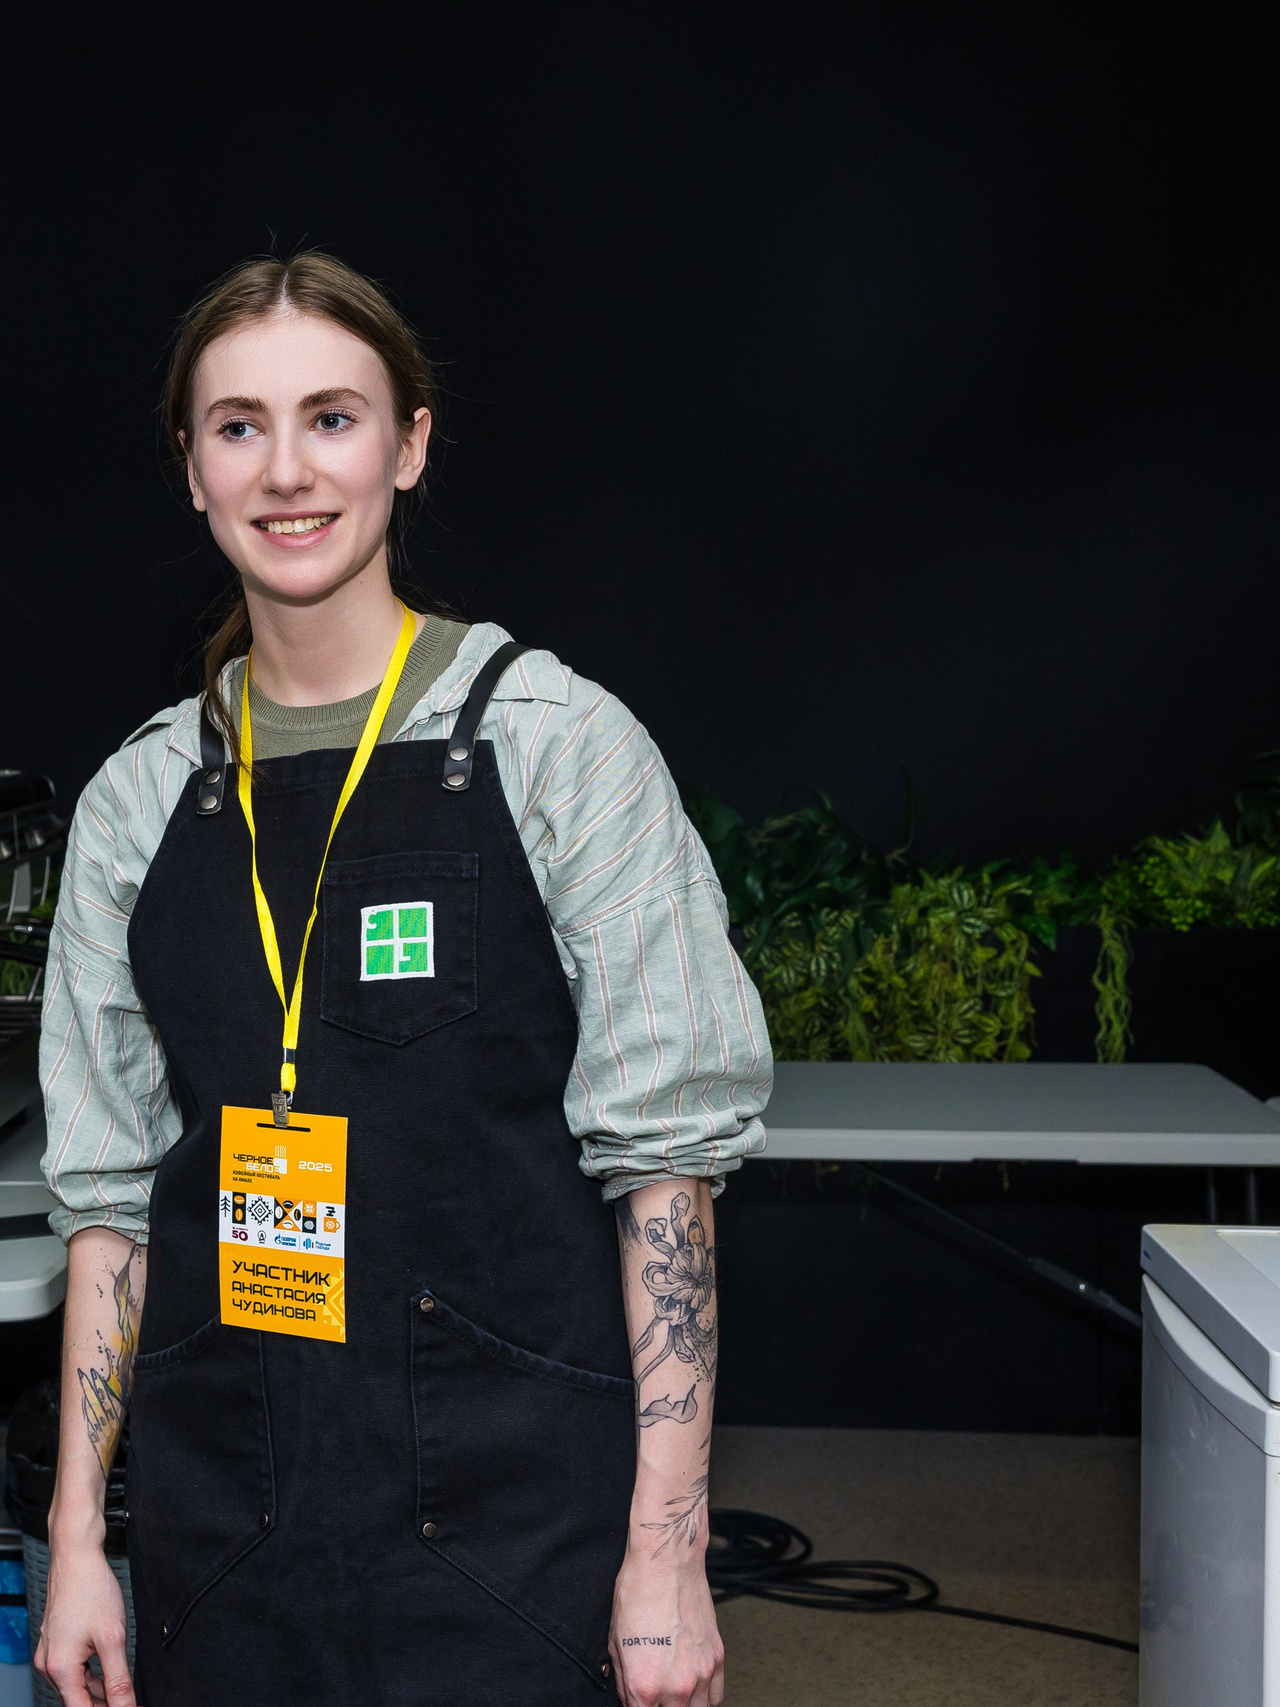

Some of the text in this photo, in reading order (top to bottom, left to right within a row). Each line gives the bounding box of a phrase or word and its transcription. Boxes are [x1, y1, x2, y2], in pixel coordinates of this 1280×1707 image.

[233, 1153, 274, 1165] ЧЕРНОЕ
[298, 1160, 333, 1172] 2025
[232, 1230, 249, 1242] 50
[232, 1260, 330, 1287] УЧАСТНИК
[232, 1281, 326, 1306] АНАСТАСИЯ
[232, 1298, 316, 1322] ЧУДИНОВА
[622, 1637, 672, 1647] FORTUNE
